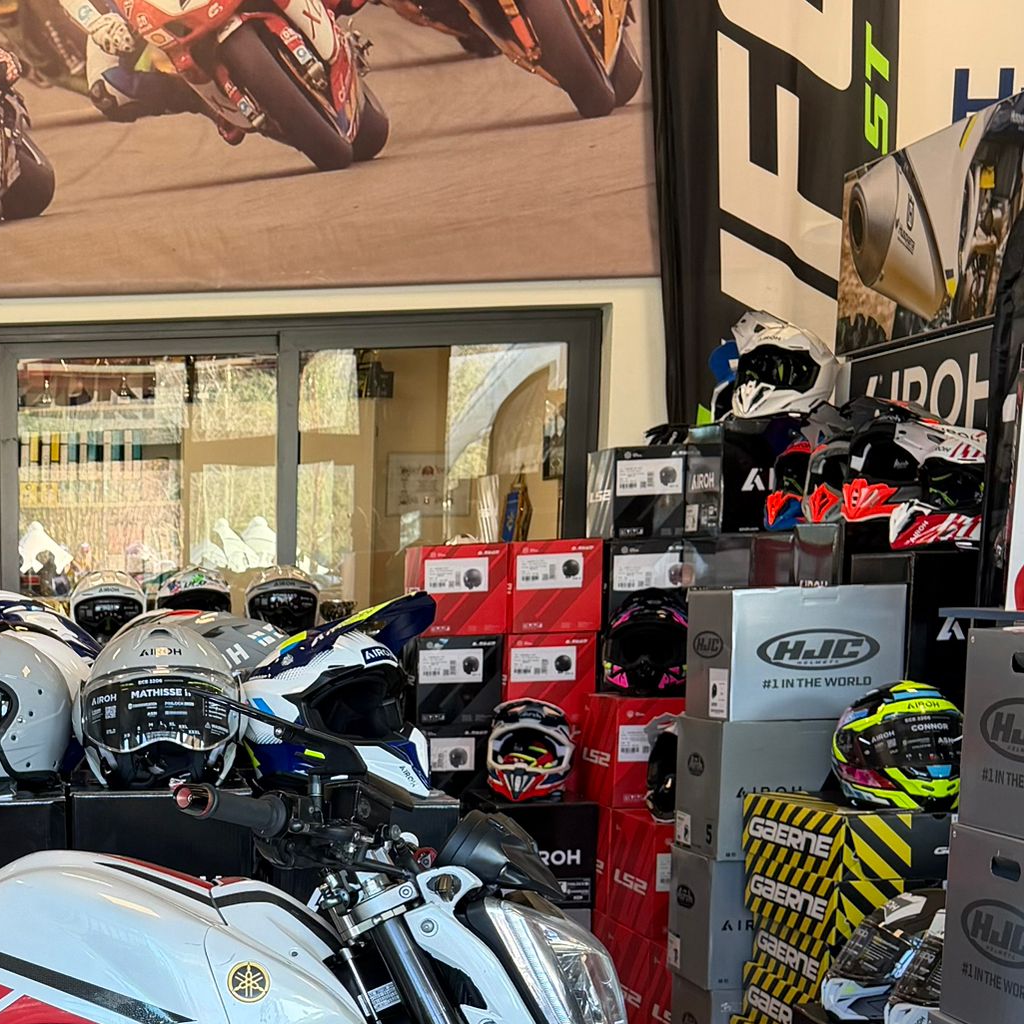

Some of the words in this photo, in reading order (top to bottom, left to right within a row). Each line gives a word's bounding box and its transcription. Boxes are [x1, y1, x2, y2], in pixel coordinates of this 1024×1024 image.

[691, 472, 715, 491] AIROH
[695, 637, 720, 652] HJC
[772, 638, 865, 661] HJC
[139, 648, 182, 657] AIROH
[762, 679, 779, 689] #1
[781, 679, 795, 689] IN
[796, 677, 823, 688] THE
[824, 675, 872, 688] WORLD
[91, 693, 117, 707] AIROH
[130, 688, 183, 700] MATHISSE
[907, 700, 941, 710] AIROH
[910, 723, 949, 732] CONNOR
[870, 730, 896, 744] AIROH
[582, 746, 611, 768] LS2
[982, 767, 993, 783] #1
[995, 769, 1005, 784] IN
[1006, 771, 1024, 789] THE
[705, 824, 713, 845] 5
[538, 848, 581, 866] ROH
[613, 868, 648, 896] LS2
[721, 919, 754, 932] AIR
[961, 961, 973, 978] #1
[974, 965, 984, 982] IN
[984, 970, 1002, 990] THE
[1003, 977, 1024, 1001] WOR
